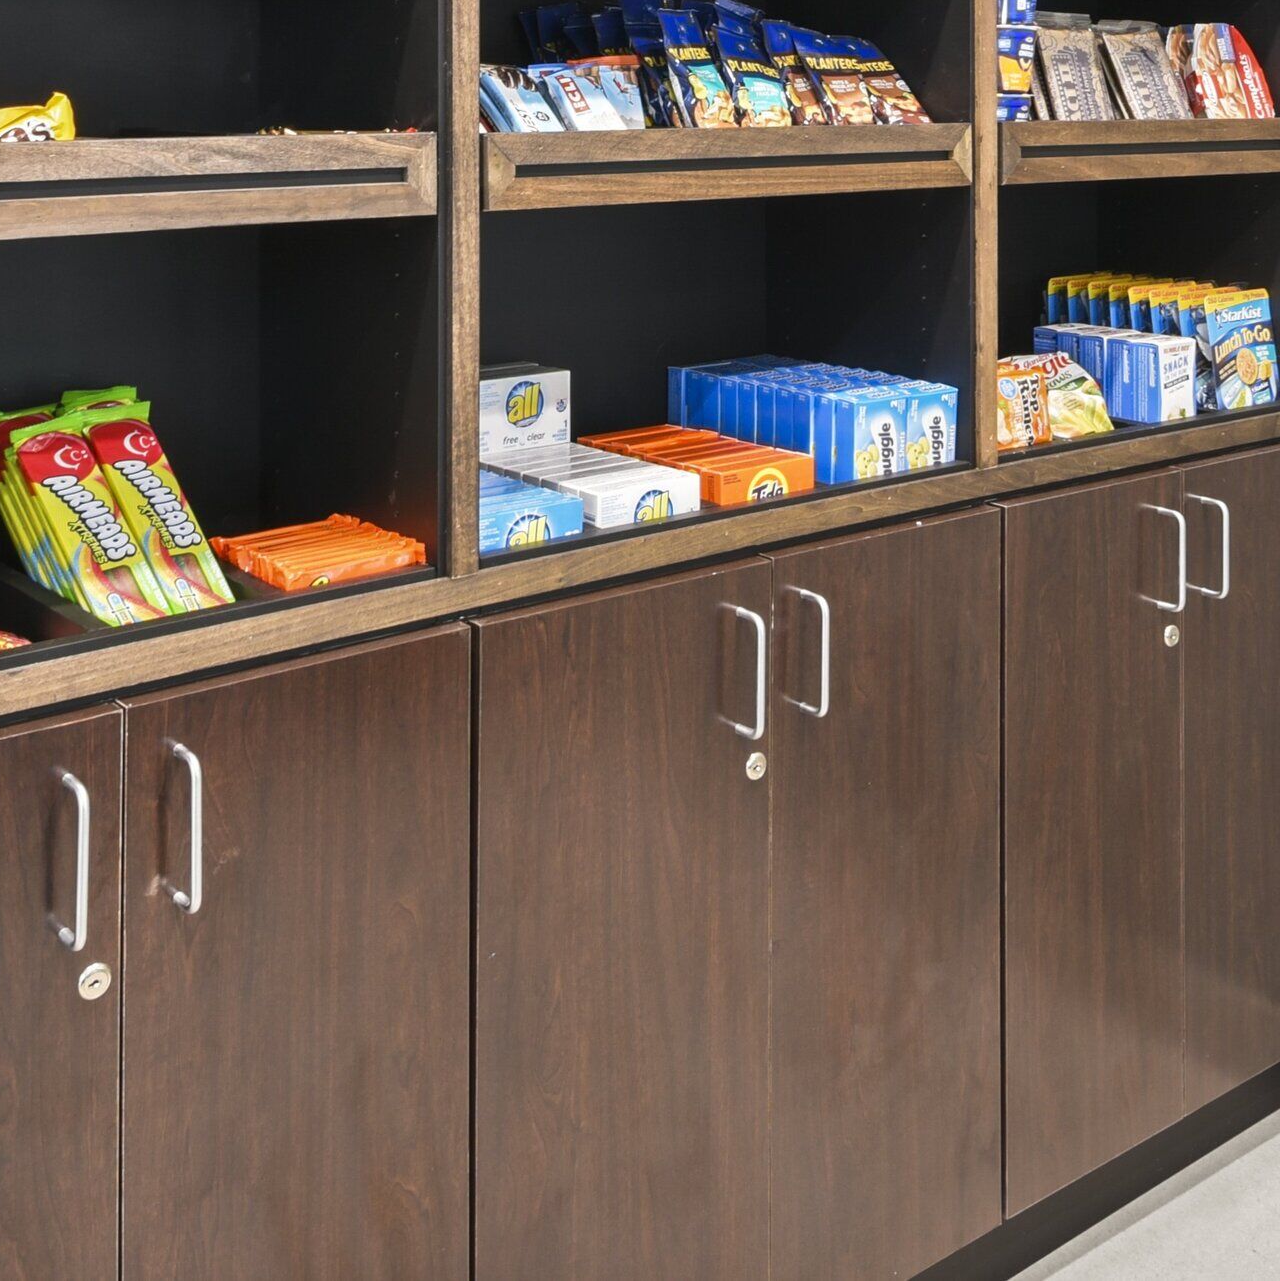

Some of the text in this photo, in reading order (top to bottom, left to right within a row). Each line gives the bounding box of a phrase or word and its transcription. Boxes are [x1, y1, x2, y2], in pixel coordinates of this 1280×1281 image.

[727, 59, 780, 78] PLANTERS
[805, 57, 860, 70] PLANTERS
[860, 61, 895, 72] NTERS
[1238, 53, 1266, 119] Compleats
[1221, 305, 1262, 323] StarKist
[1214, 325, 1271, 364] Lunch To-Go
[1163, 355, 1189, 374] SNACK
[508, 383, 540, 423] all
[1029, 374, 1040, 412] Top
[503, 436, 519, 445] free
[527, 432, 546, 442] clear
[878, 422, 894, 476] nuggle
[929, 416, 944, 465] nuggle
[42, 475, 137, 560] AIRHEADS
[113, 459, 202, 548] AIRHEADS
[637, 491, 670, 522] all
[68, 520, 108, 564] XTREMES
[138, 504, 175, 550] XTREMES
[509, 515, 547, 549] all
